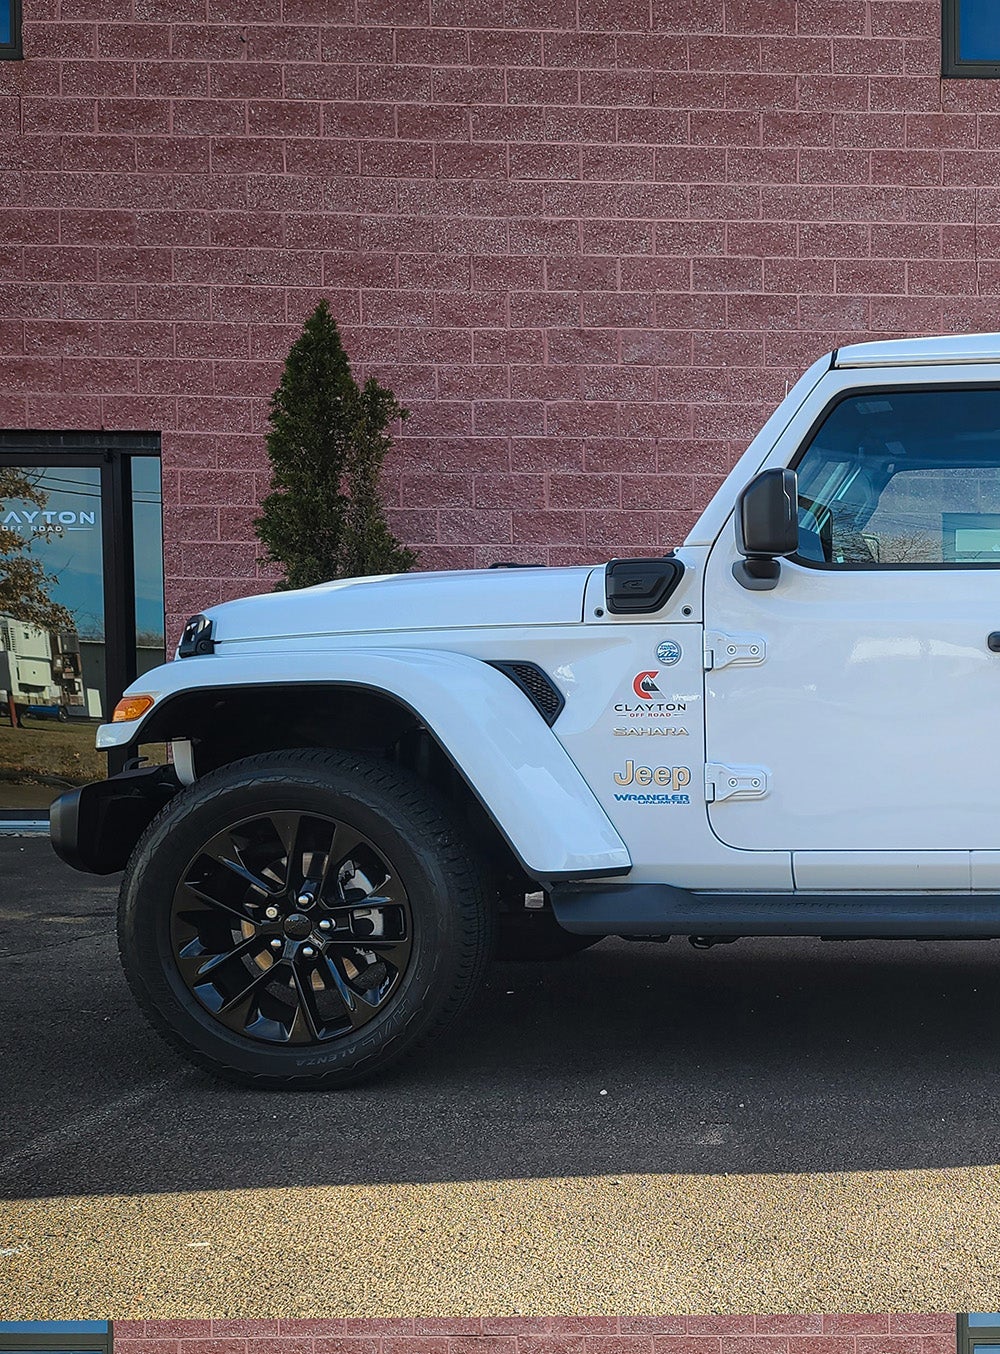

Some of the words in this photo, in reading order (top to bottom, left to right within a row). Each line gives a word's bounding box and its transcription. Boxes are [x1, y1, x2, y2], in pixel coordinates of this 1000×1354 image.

[614, 703, 687, 712] CLAYTON
[613, 727, 689, 736] SAHARA
[614, 760, 691, 790] Jeep
[614, 794, 689, 802] WRANGLER
